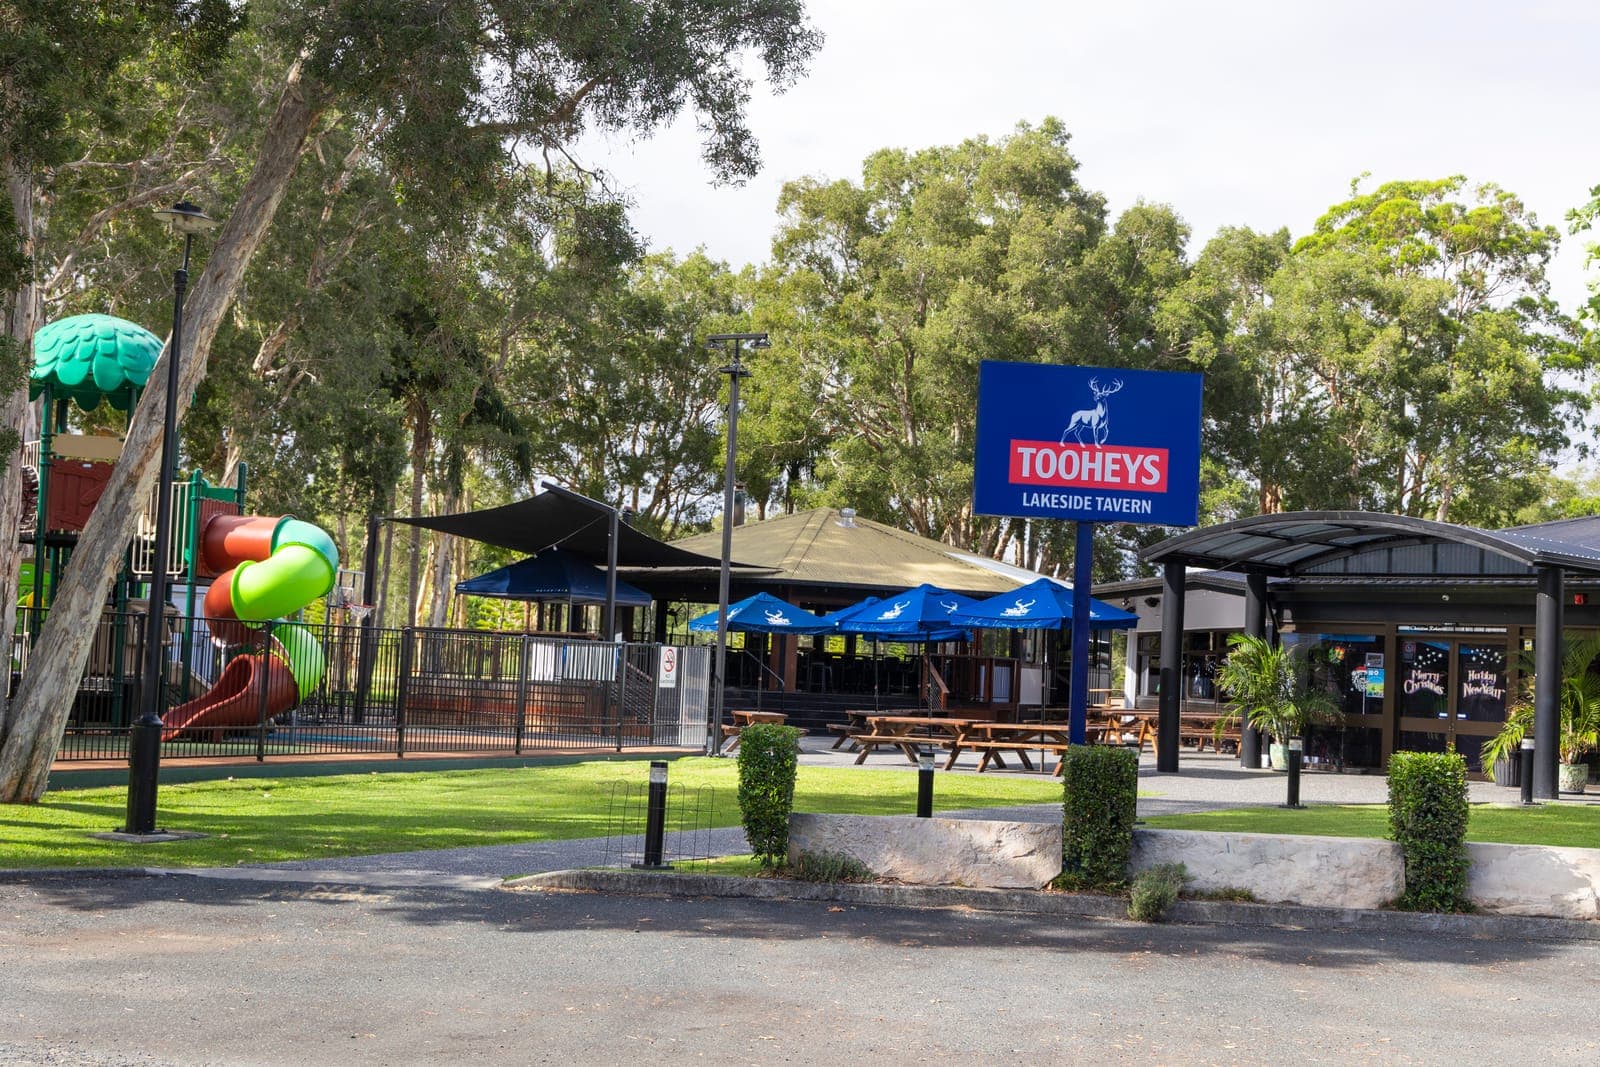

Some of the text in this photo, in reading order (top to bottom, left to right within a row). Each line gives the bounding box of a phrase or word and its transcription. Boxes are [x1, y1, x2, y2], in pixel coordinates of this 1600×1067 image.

[1017, 447, 1161, 486] TOOHEYS
[1022, 492, 1152, 514] LAKESIDE TAVERN
[1411, 669, 1440, 684] Merry
[1403, 679, 1445, 696] Christmas
